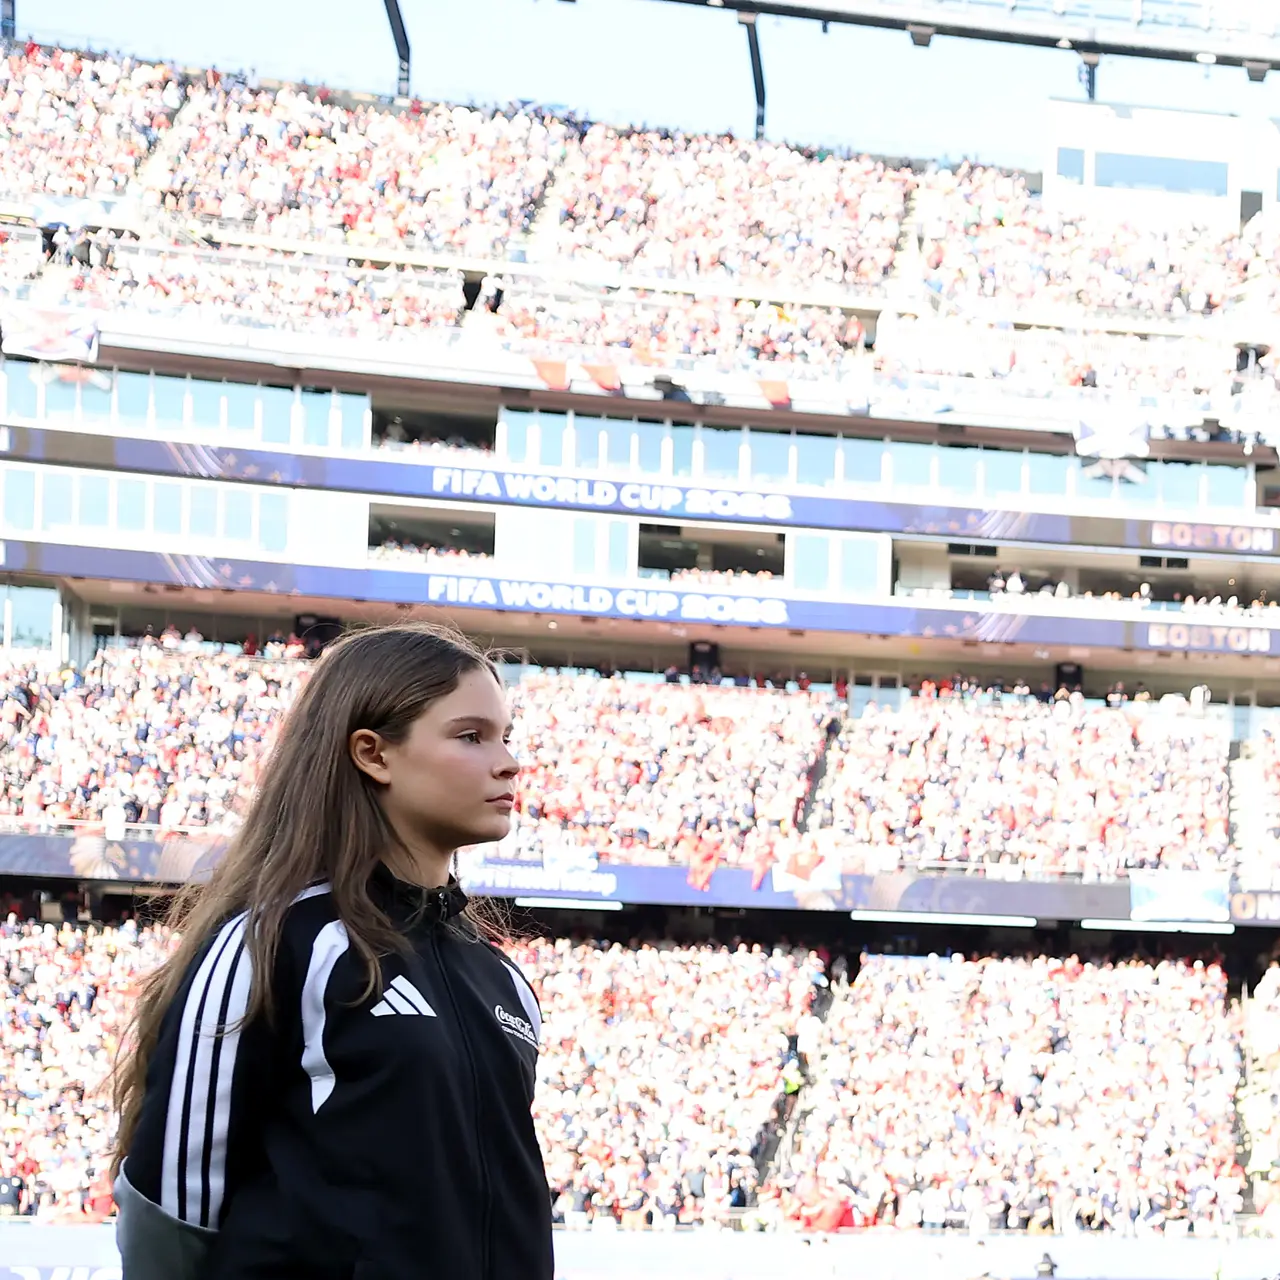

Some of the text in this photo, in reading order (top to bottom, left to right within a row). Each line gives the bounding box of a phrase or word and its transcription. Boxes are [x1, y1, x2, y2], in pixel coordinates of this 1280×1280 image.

[432, 468, 793, 520] FIFA WORLD CUP 2026
[1152, 522, 1274, 551] BOSTON
[428, 575, 790, 624] FIFA WORLD CUP 2026
[1148, 624, 1270, 652] BOSTON
